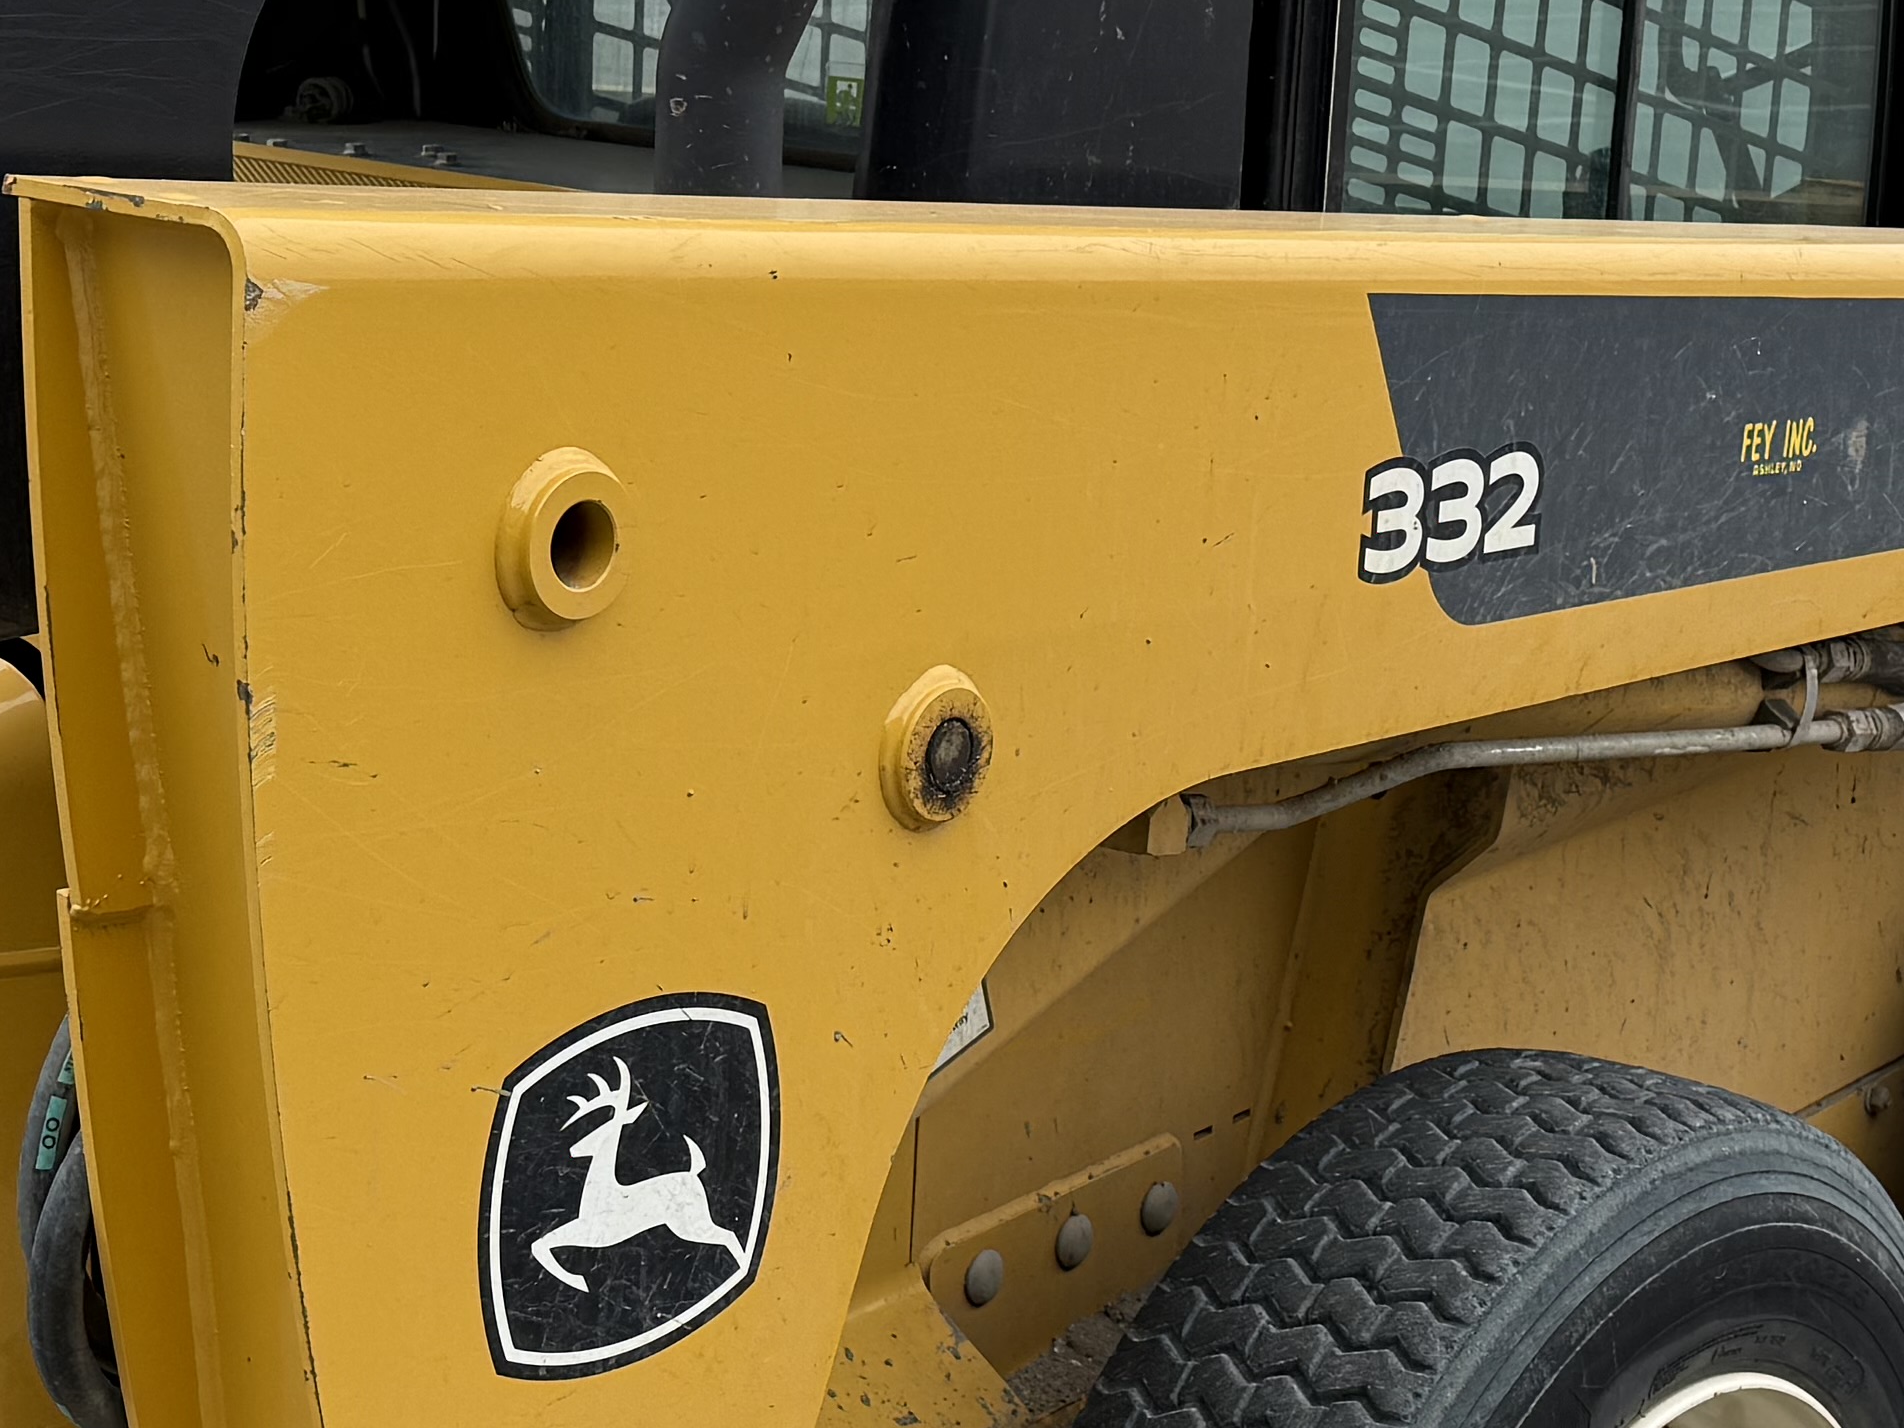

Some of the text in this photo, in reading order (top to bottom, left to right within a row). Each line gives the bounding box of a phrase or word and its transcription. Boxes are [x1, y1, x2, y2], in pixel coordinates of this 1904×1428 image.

[1740, 416, 1817, 463] FEY INC.
[1362, 449, 1538, 577] 332
